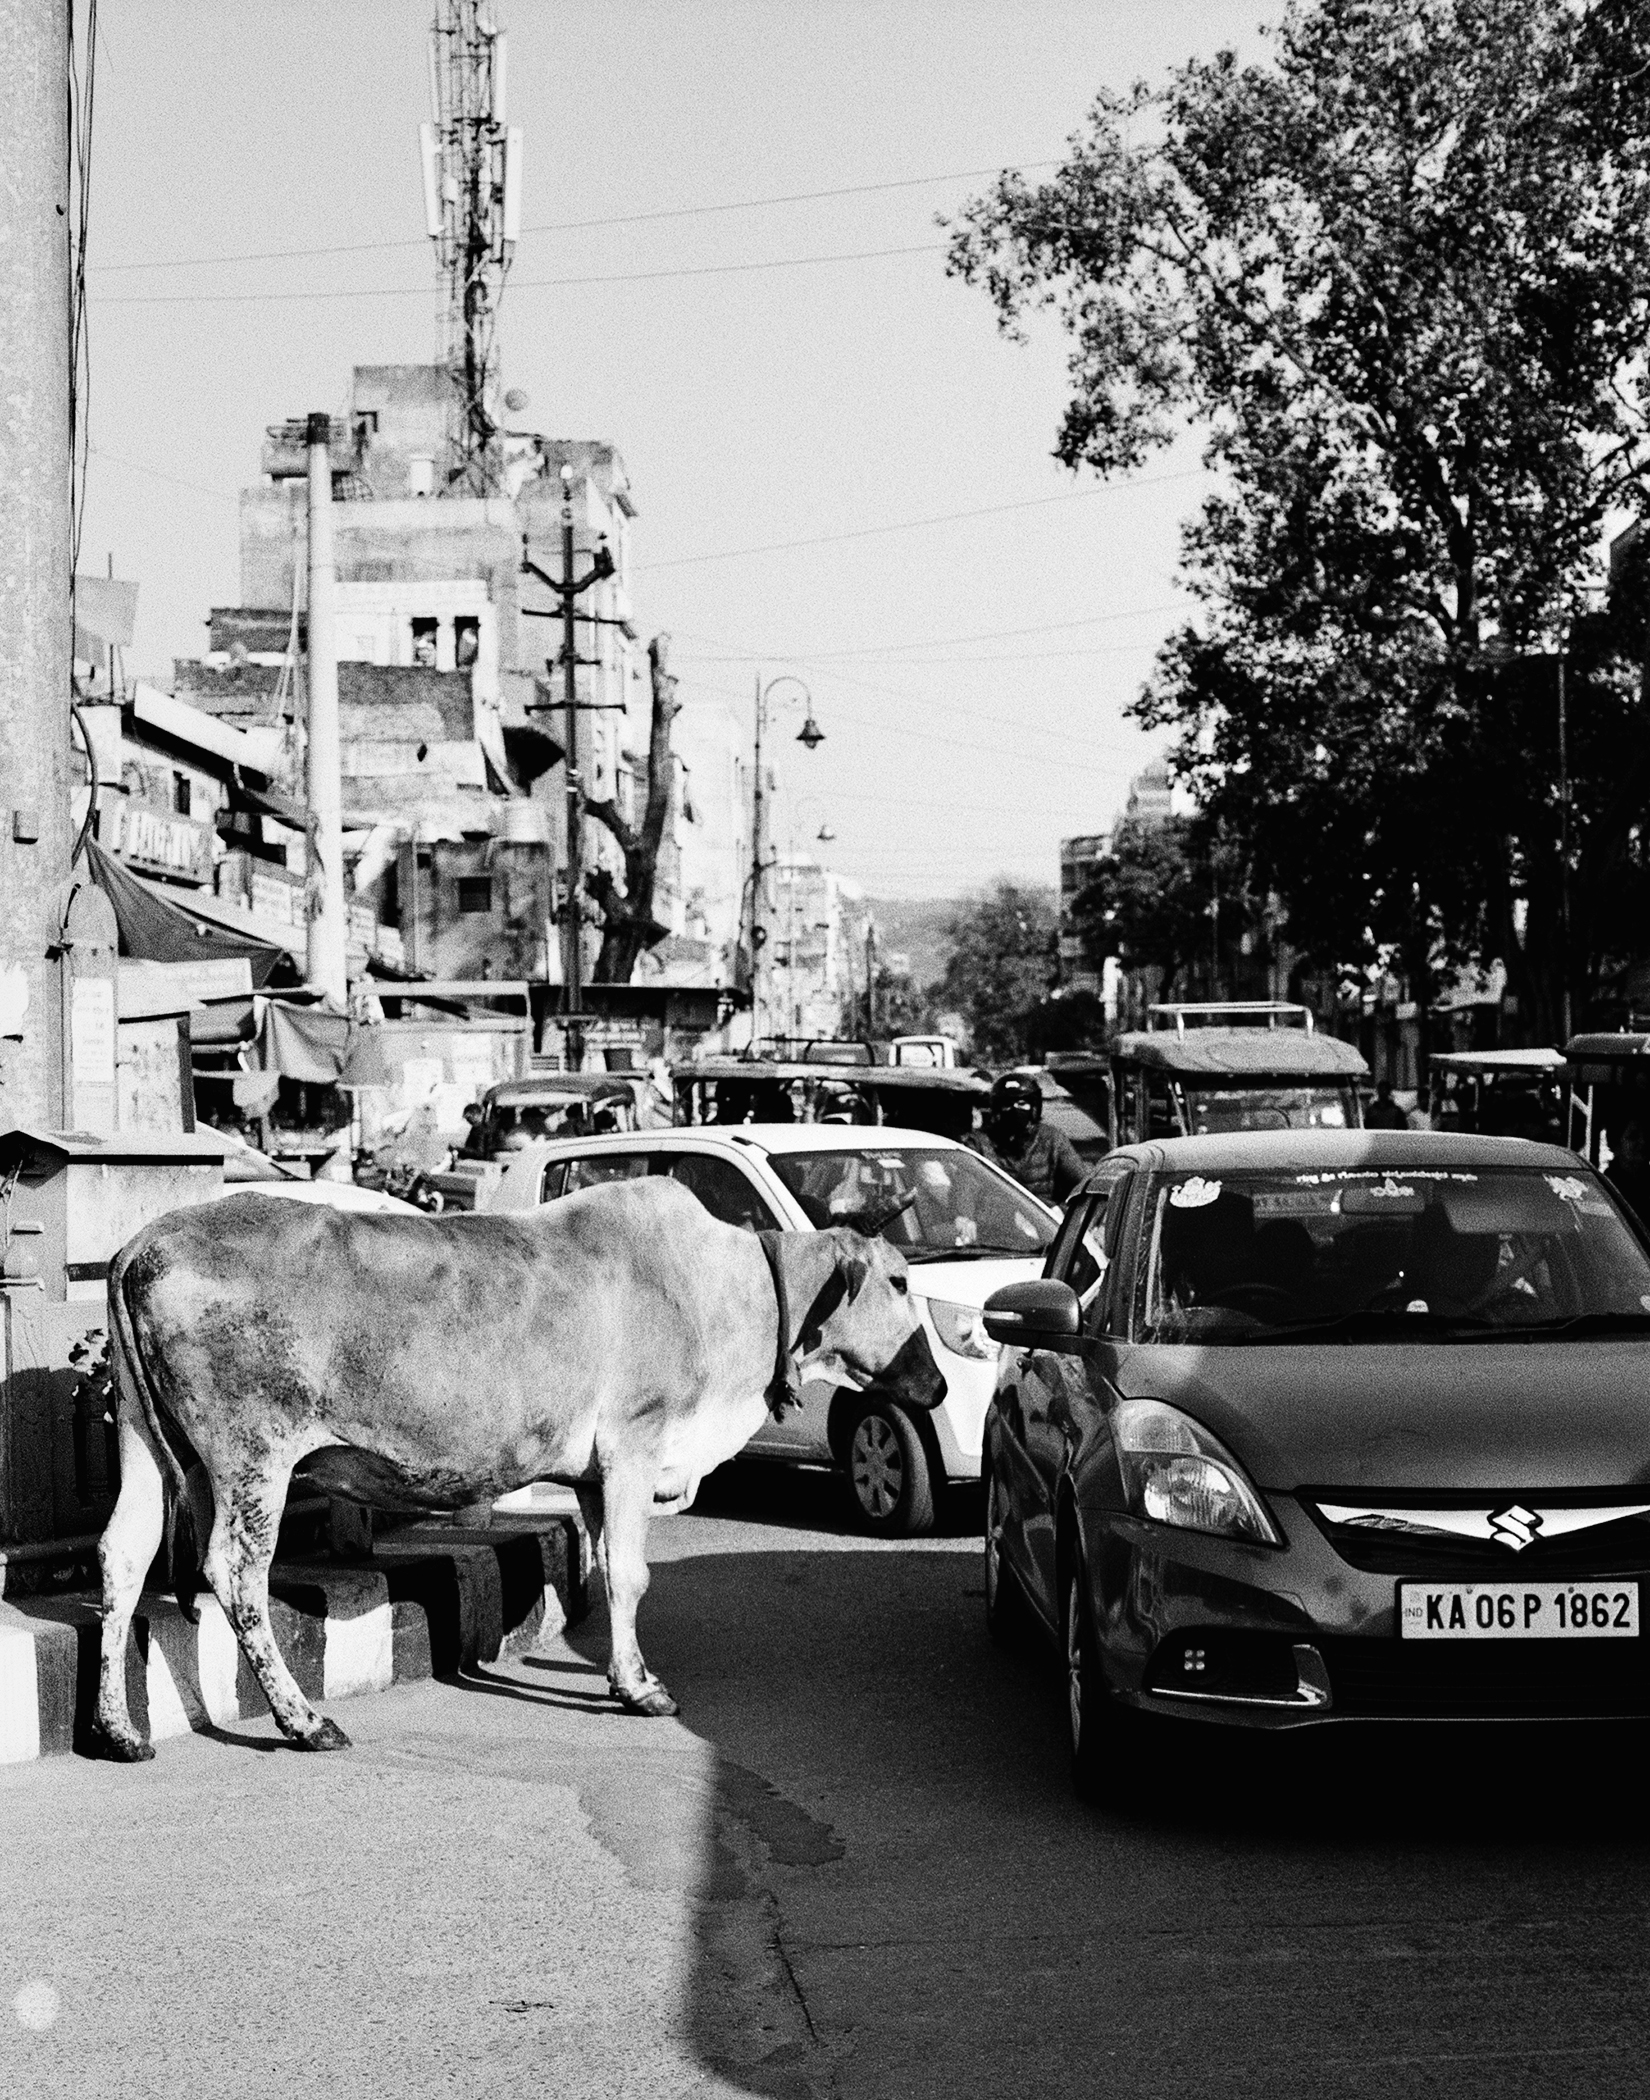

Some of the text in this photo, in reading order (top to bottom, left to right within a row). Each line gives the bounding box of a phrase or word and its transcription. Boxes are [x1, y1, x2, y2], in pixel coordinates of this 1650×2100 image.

[1404, 1607, 1424, 1618] IND
[1426, 1592, 1631, 1629] KA 06 P 1862
